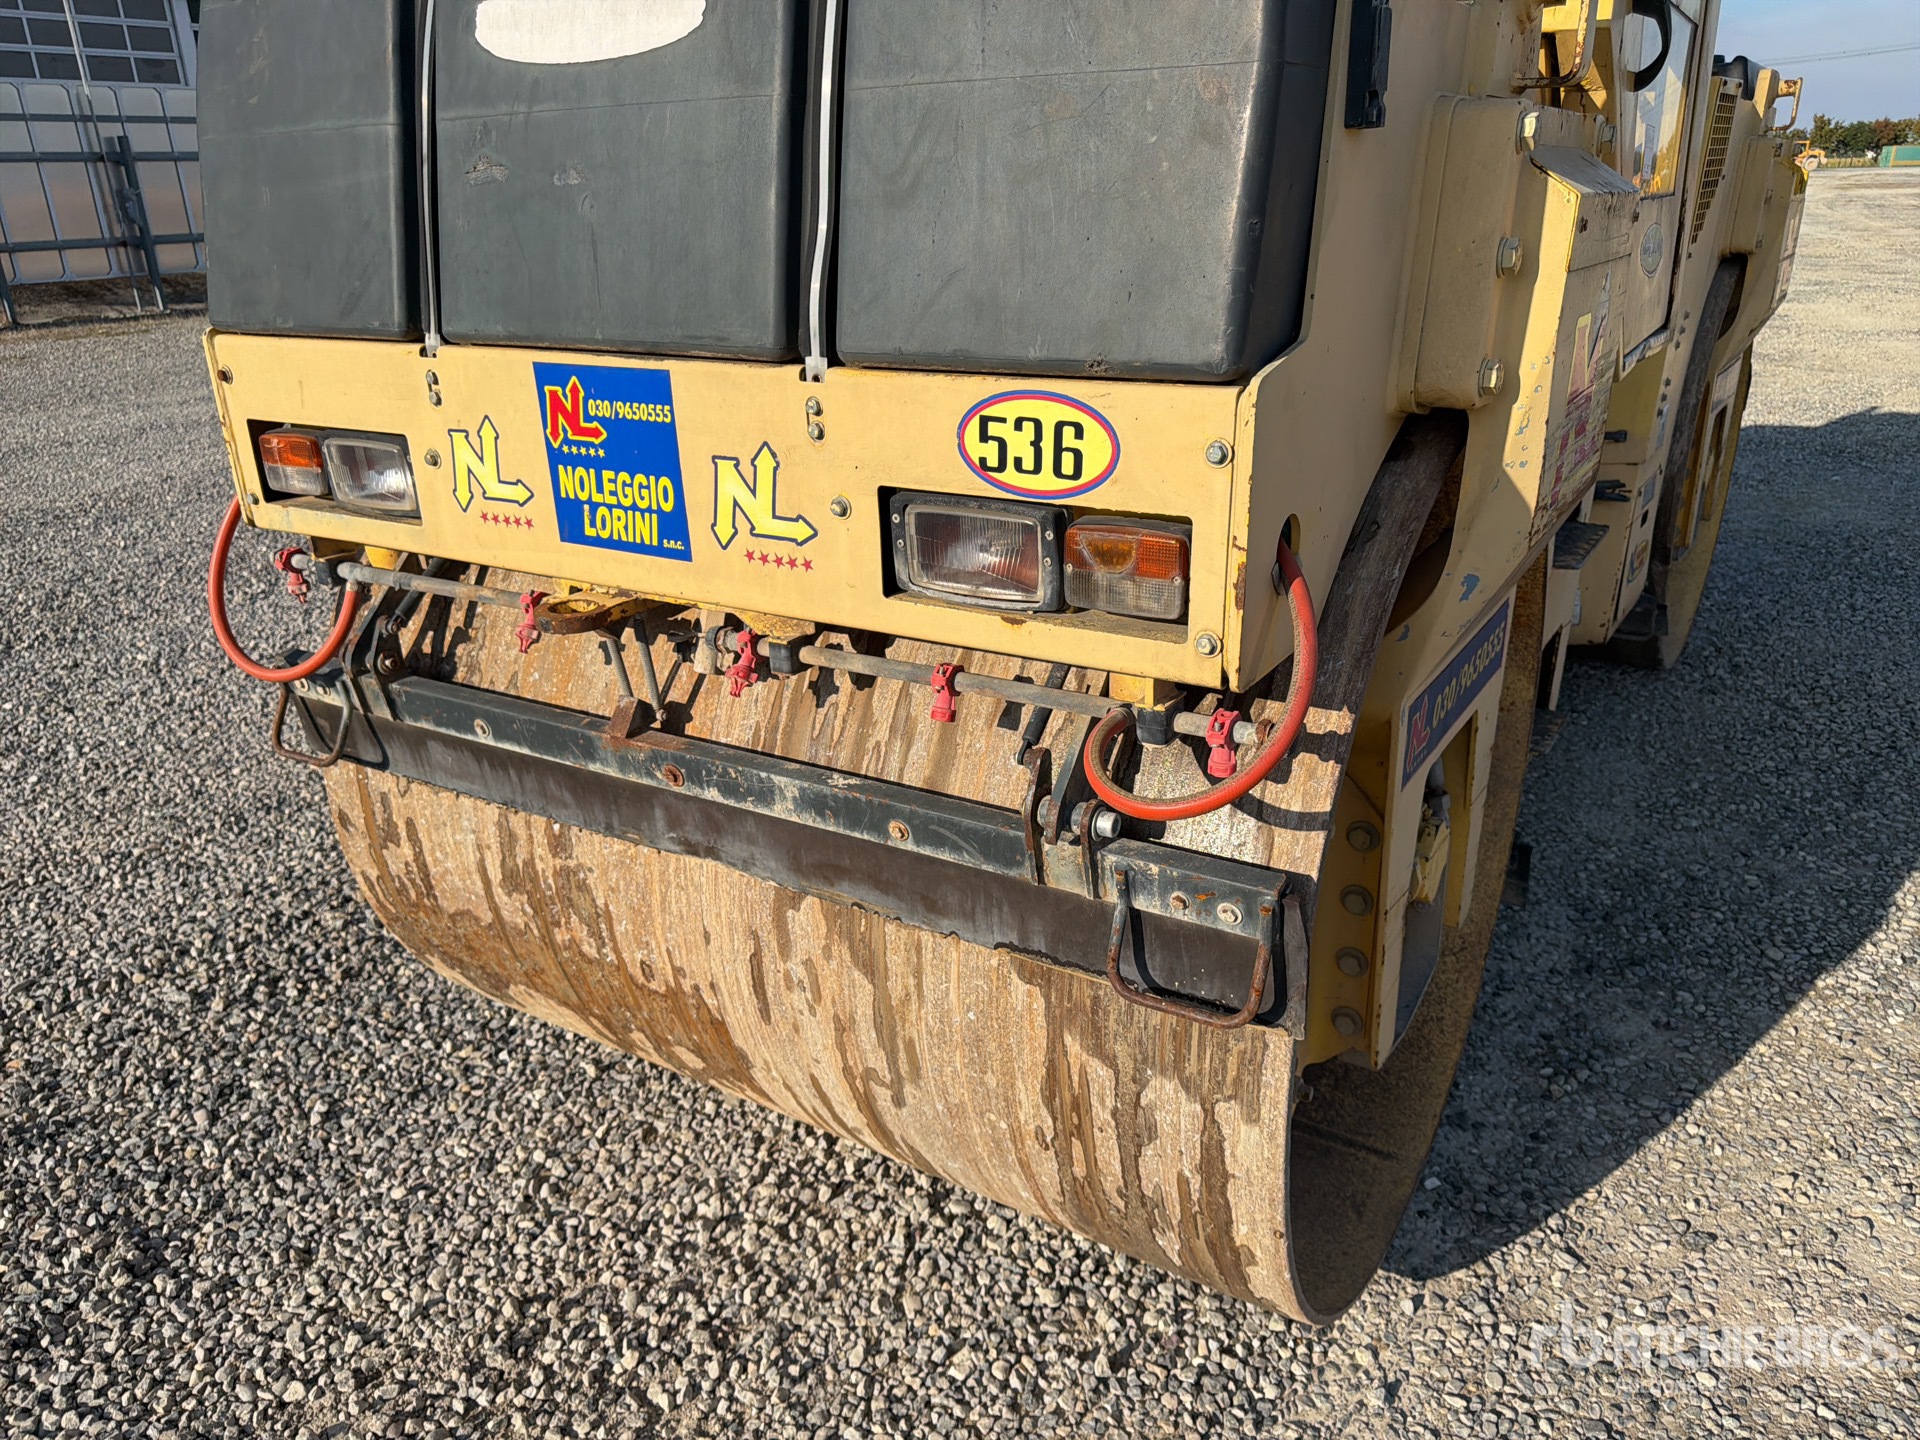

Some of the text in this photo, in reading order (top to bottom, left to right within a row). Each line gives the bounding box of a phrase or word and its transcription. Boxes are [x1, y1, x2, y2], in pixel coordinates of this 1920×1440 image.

[588, 398, 671, 424] 030/9650555
[978, 414, 1085, 481] 536
[558, 464, 674, 512] NOLEGGIO
[583, 504, 658, 546] LORINI
[1432, 621, 1506, 728] 030/9650555
